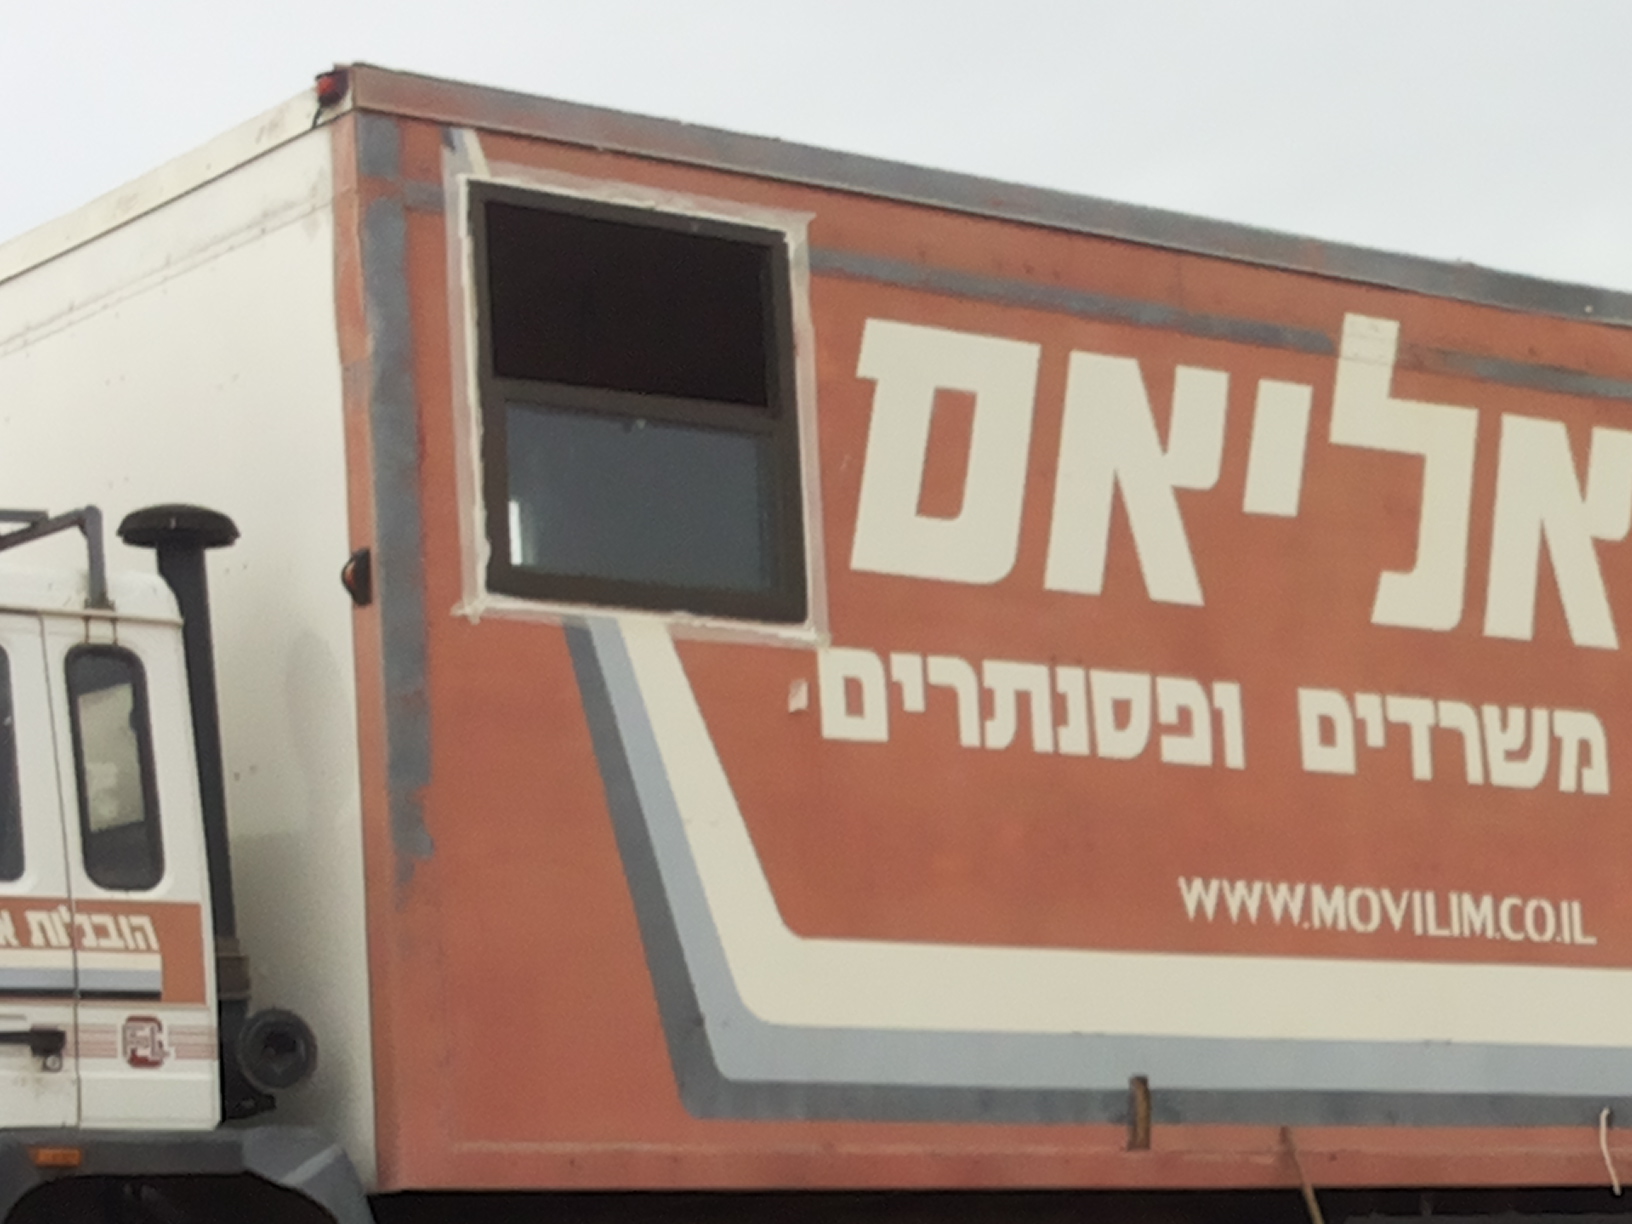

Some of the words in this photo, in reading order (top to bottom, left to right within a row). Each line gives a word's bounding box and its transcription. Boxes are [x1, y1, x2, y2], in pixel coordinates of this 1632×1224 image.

[818, 646, 1246, 770] ופסנתרים
[1296, 686, 1610, 795] משרדים
[1178, 876, 1598, 946] WWW.MOVILIM.CO.IL
